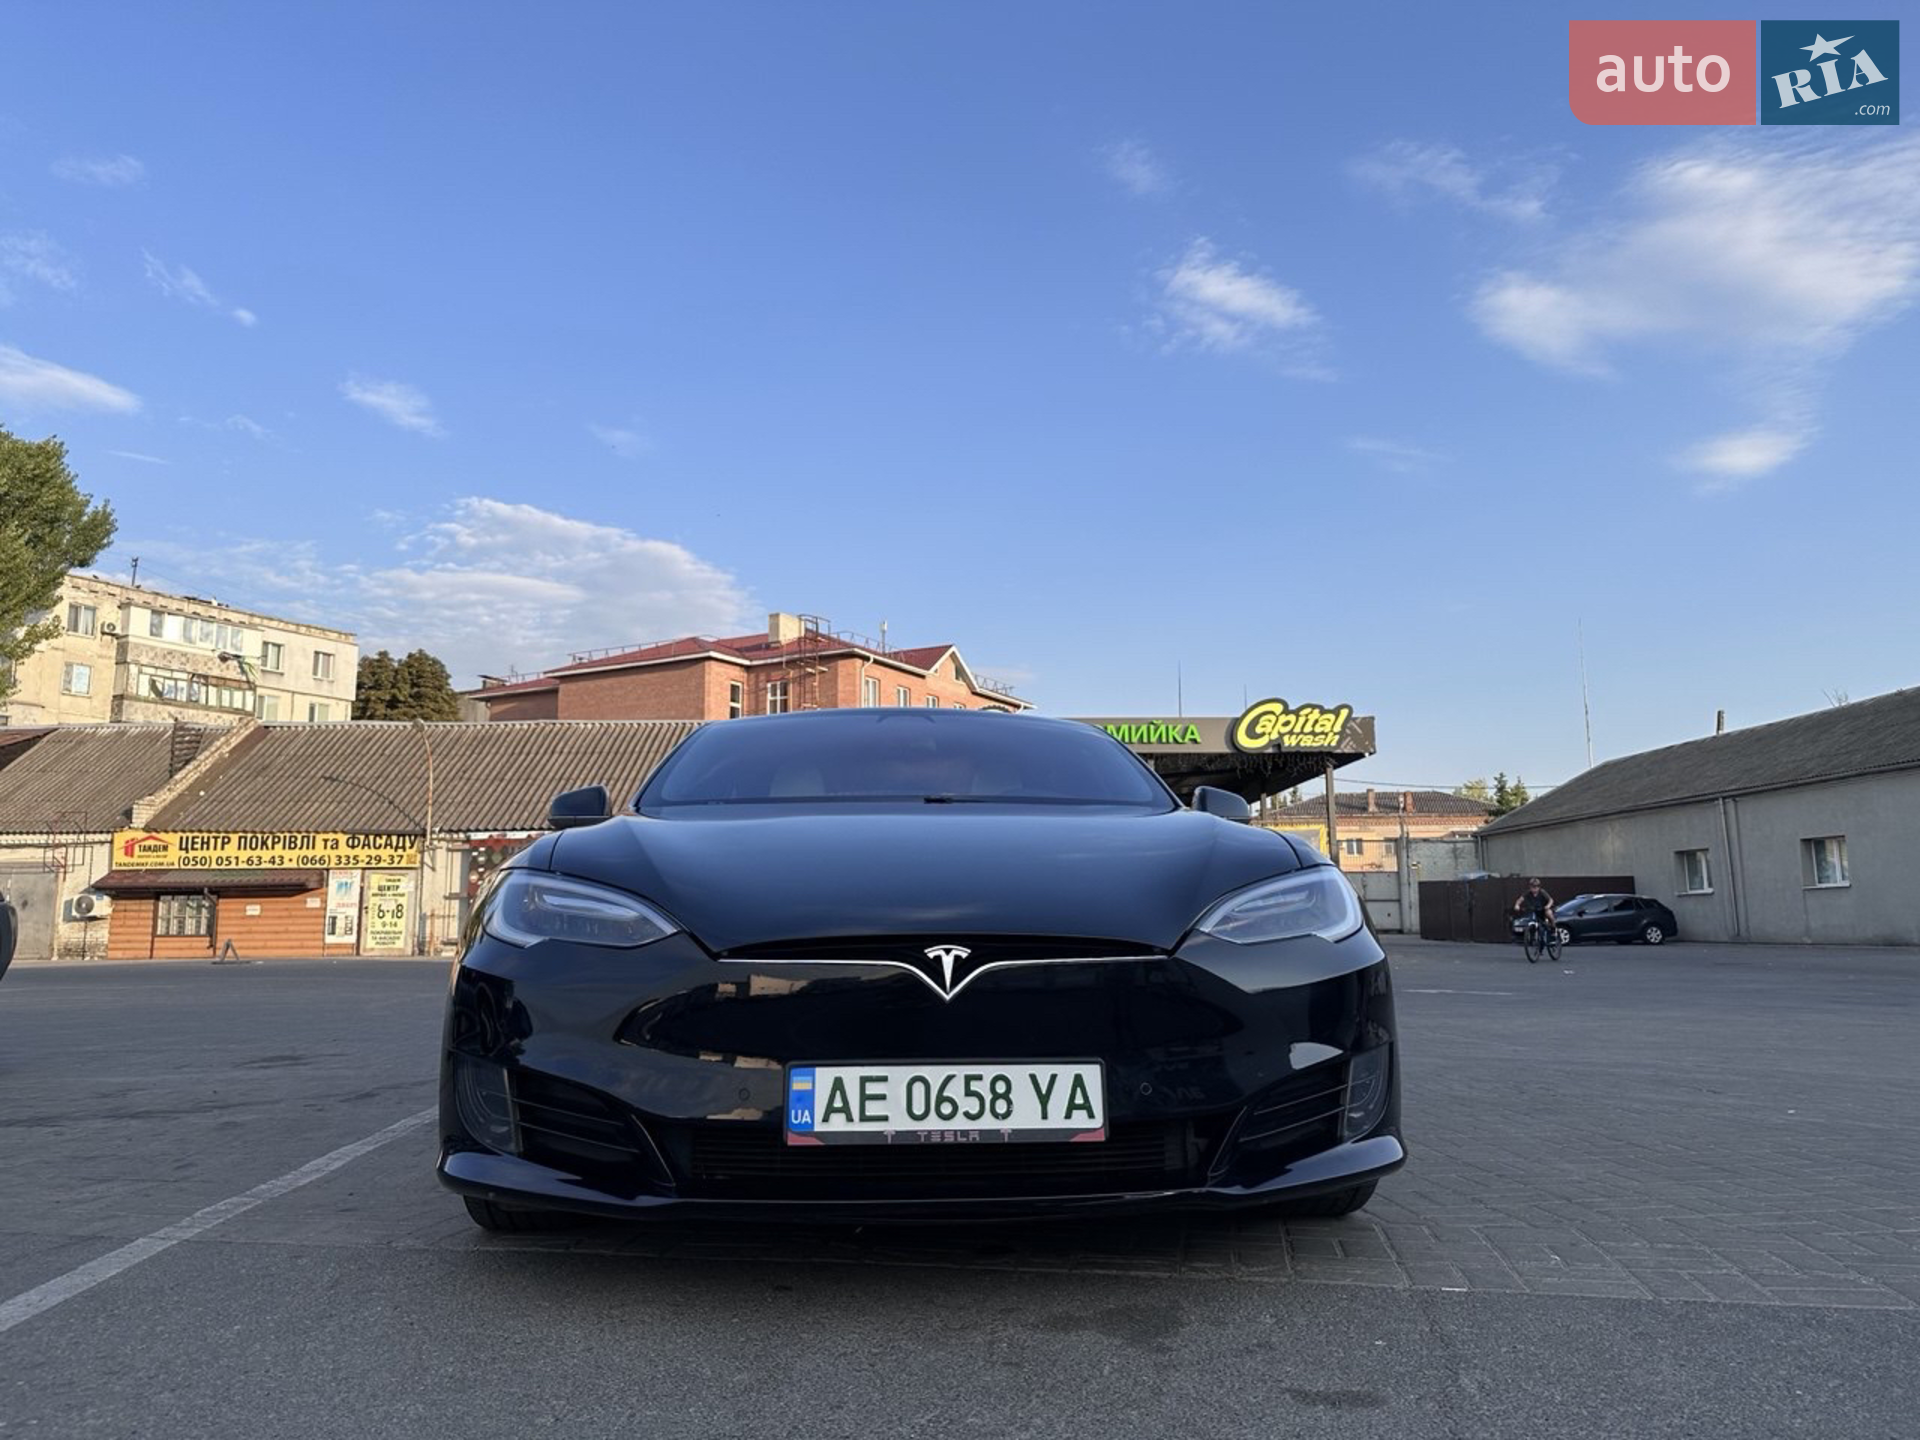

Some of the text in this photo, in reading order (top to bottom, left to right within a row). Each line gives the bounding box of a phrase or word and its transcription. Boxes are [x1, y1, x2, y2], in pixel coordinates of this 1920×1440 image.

[1096, 719, 1201, 744] МИЙКА
[1236, 701, 1350, 749] Capital
[1283, 732, 1341, 748] wash
[178, 833, 418, 854] ЦЕНТР ПОКРІВЛІ та ФАСАДУ
[177, 854, 404, 868] (050) 051-63-43 (066) 335-29-37
[821, 1073, 1096, 1123] AE 0658 YA
[791, 1109, 812, 1125] UA
[916, 1130, 981, 1142] TESLA
